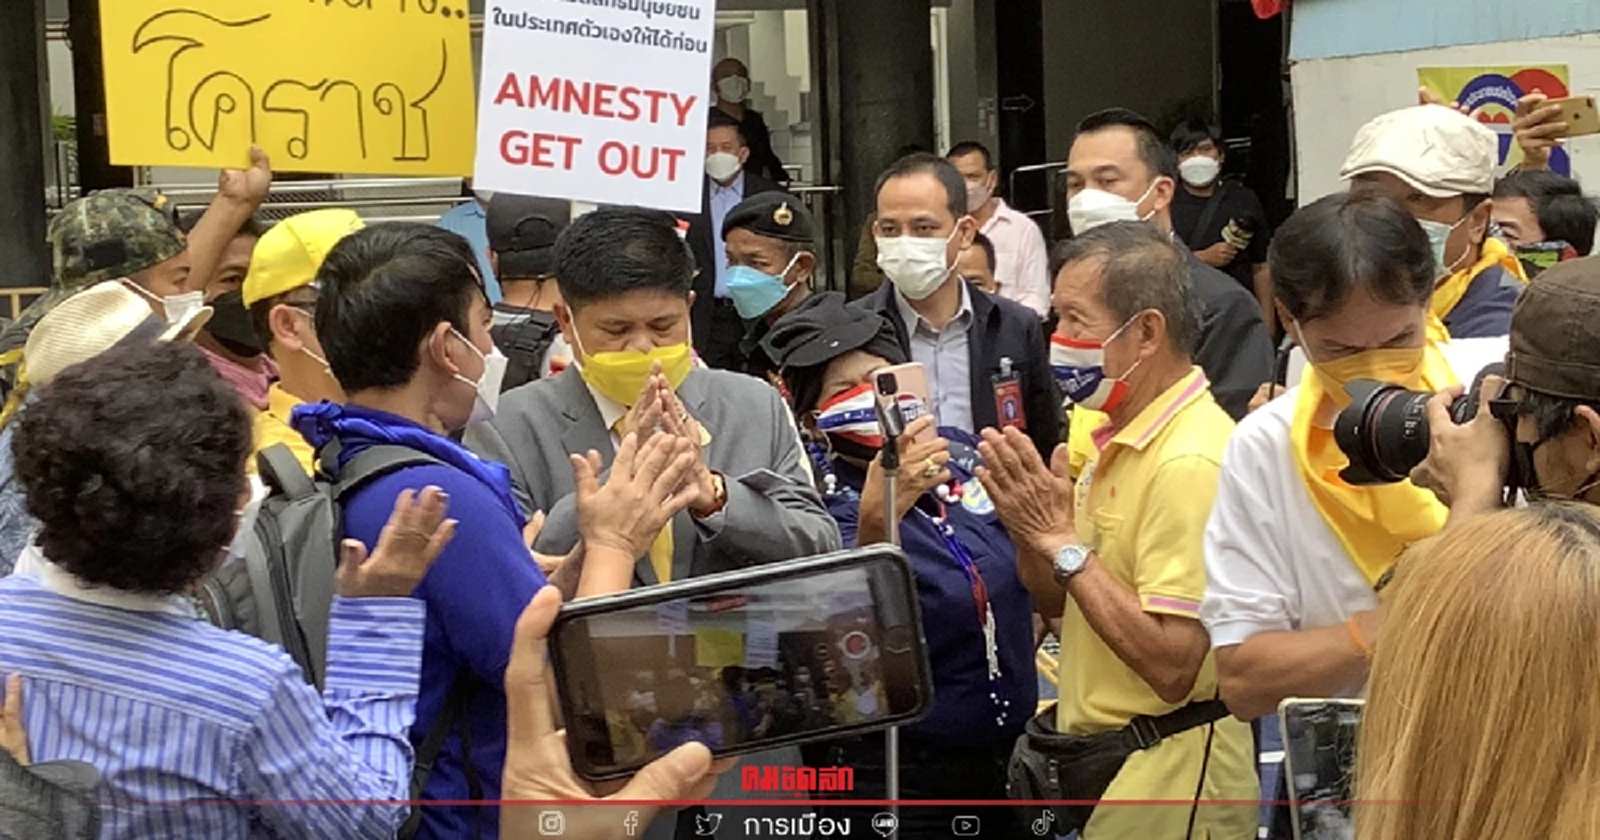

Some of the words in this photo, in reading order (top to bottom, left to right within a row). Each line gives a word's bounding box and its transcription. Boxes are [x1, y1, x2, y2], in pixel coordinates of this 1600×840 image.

[492, 6, 708, 53] ในประเทศตัวเองให้ได้ก่อน
[132, 9, 447, 161] โคราช
[493, 72, 697, 127] AMNESTY
[499, 129, 583, 171] GET
[597, 141, 686, 182] OUT
